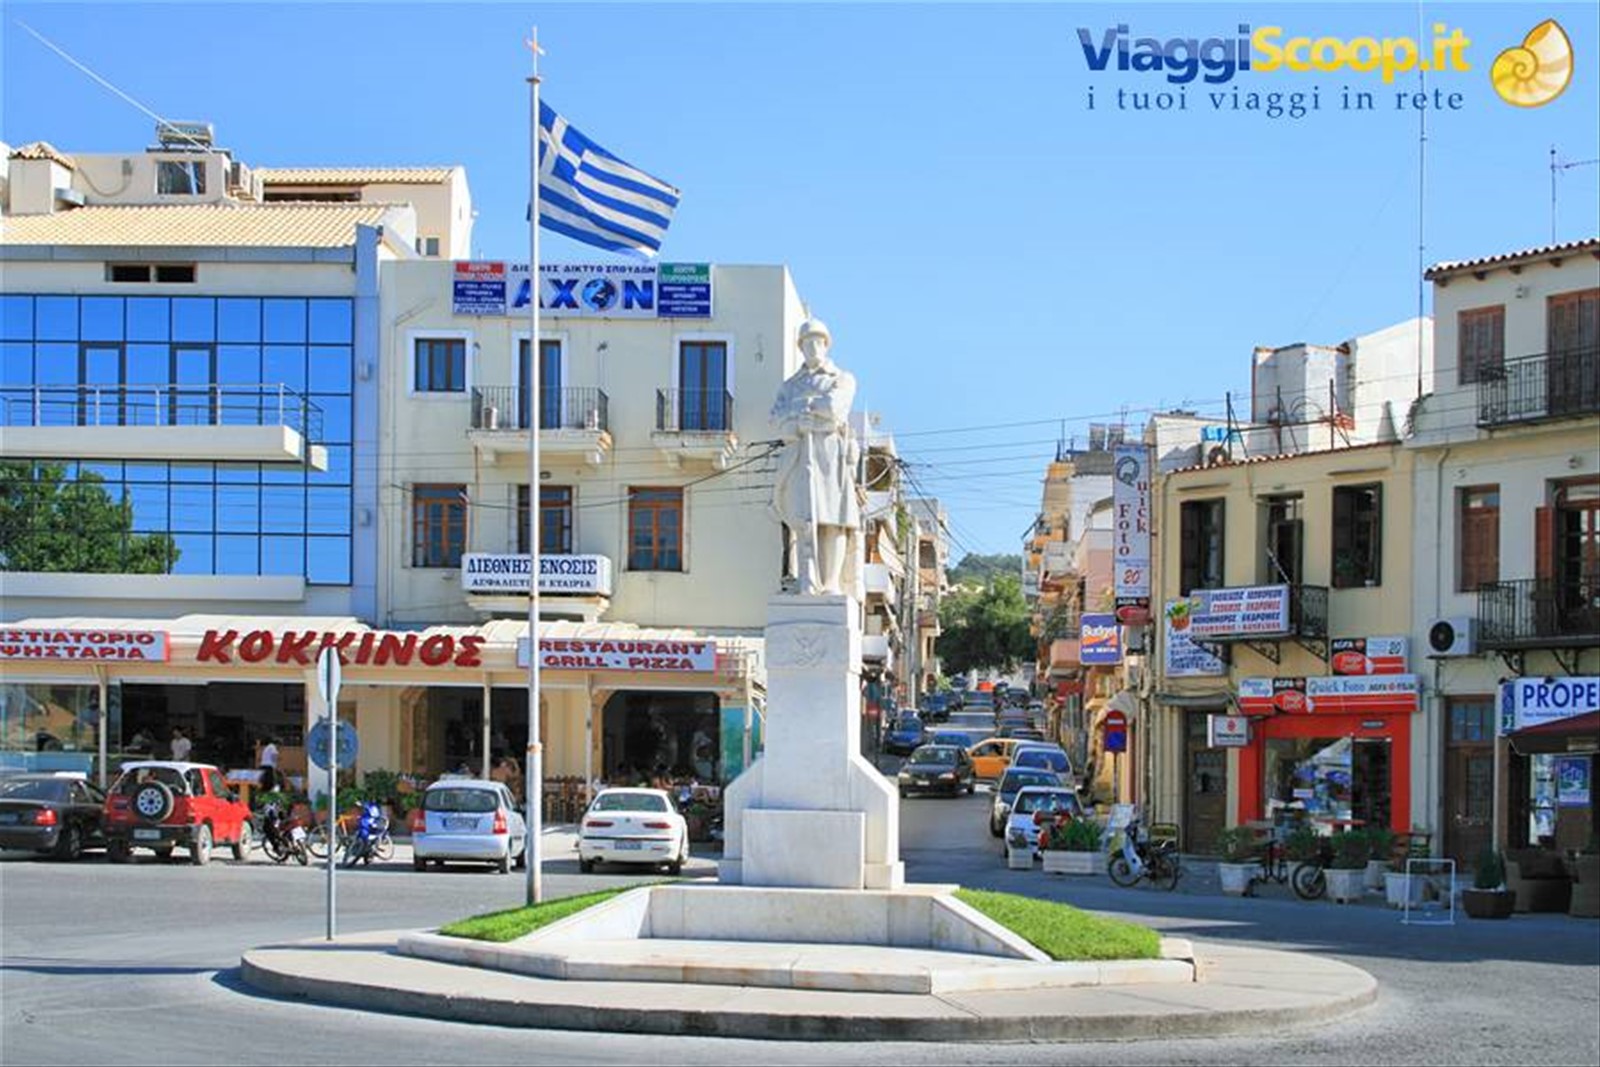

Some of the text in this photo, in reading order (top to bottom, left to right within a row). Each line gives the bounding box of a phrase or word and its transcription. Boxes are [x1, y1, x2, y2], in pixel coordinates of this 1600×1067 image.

[511, 264, 656, 274] ΔΙΕΝΕΣ ΔΙΚΤΥΟ ΣΠΟΥΔΩΝ
[1118, 504, 1131, 556] Foto
[468, 558, 597, 575] ΔΙΕΘΝΗΣ ΕΝΩΣΙΣ
[0, 645, 145, 659] ΨΗΣΤΑΡΙΑ
[196, 629, 486, 668] ΚΟΚΚΙΝΟΣ
[539, 640, 706, 655] RESTAURANT
[544, 655, 609, 668] GRILL
[628, 656, 694, 670] PIZZA
[1523, 683, 1597, 708] PROPE
